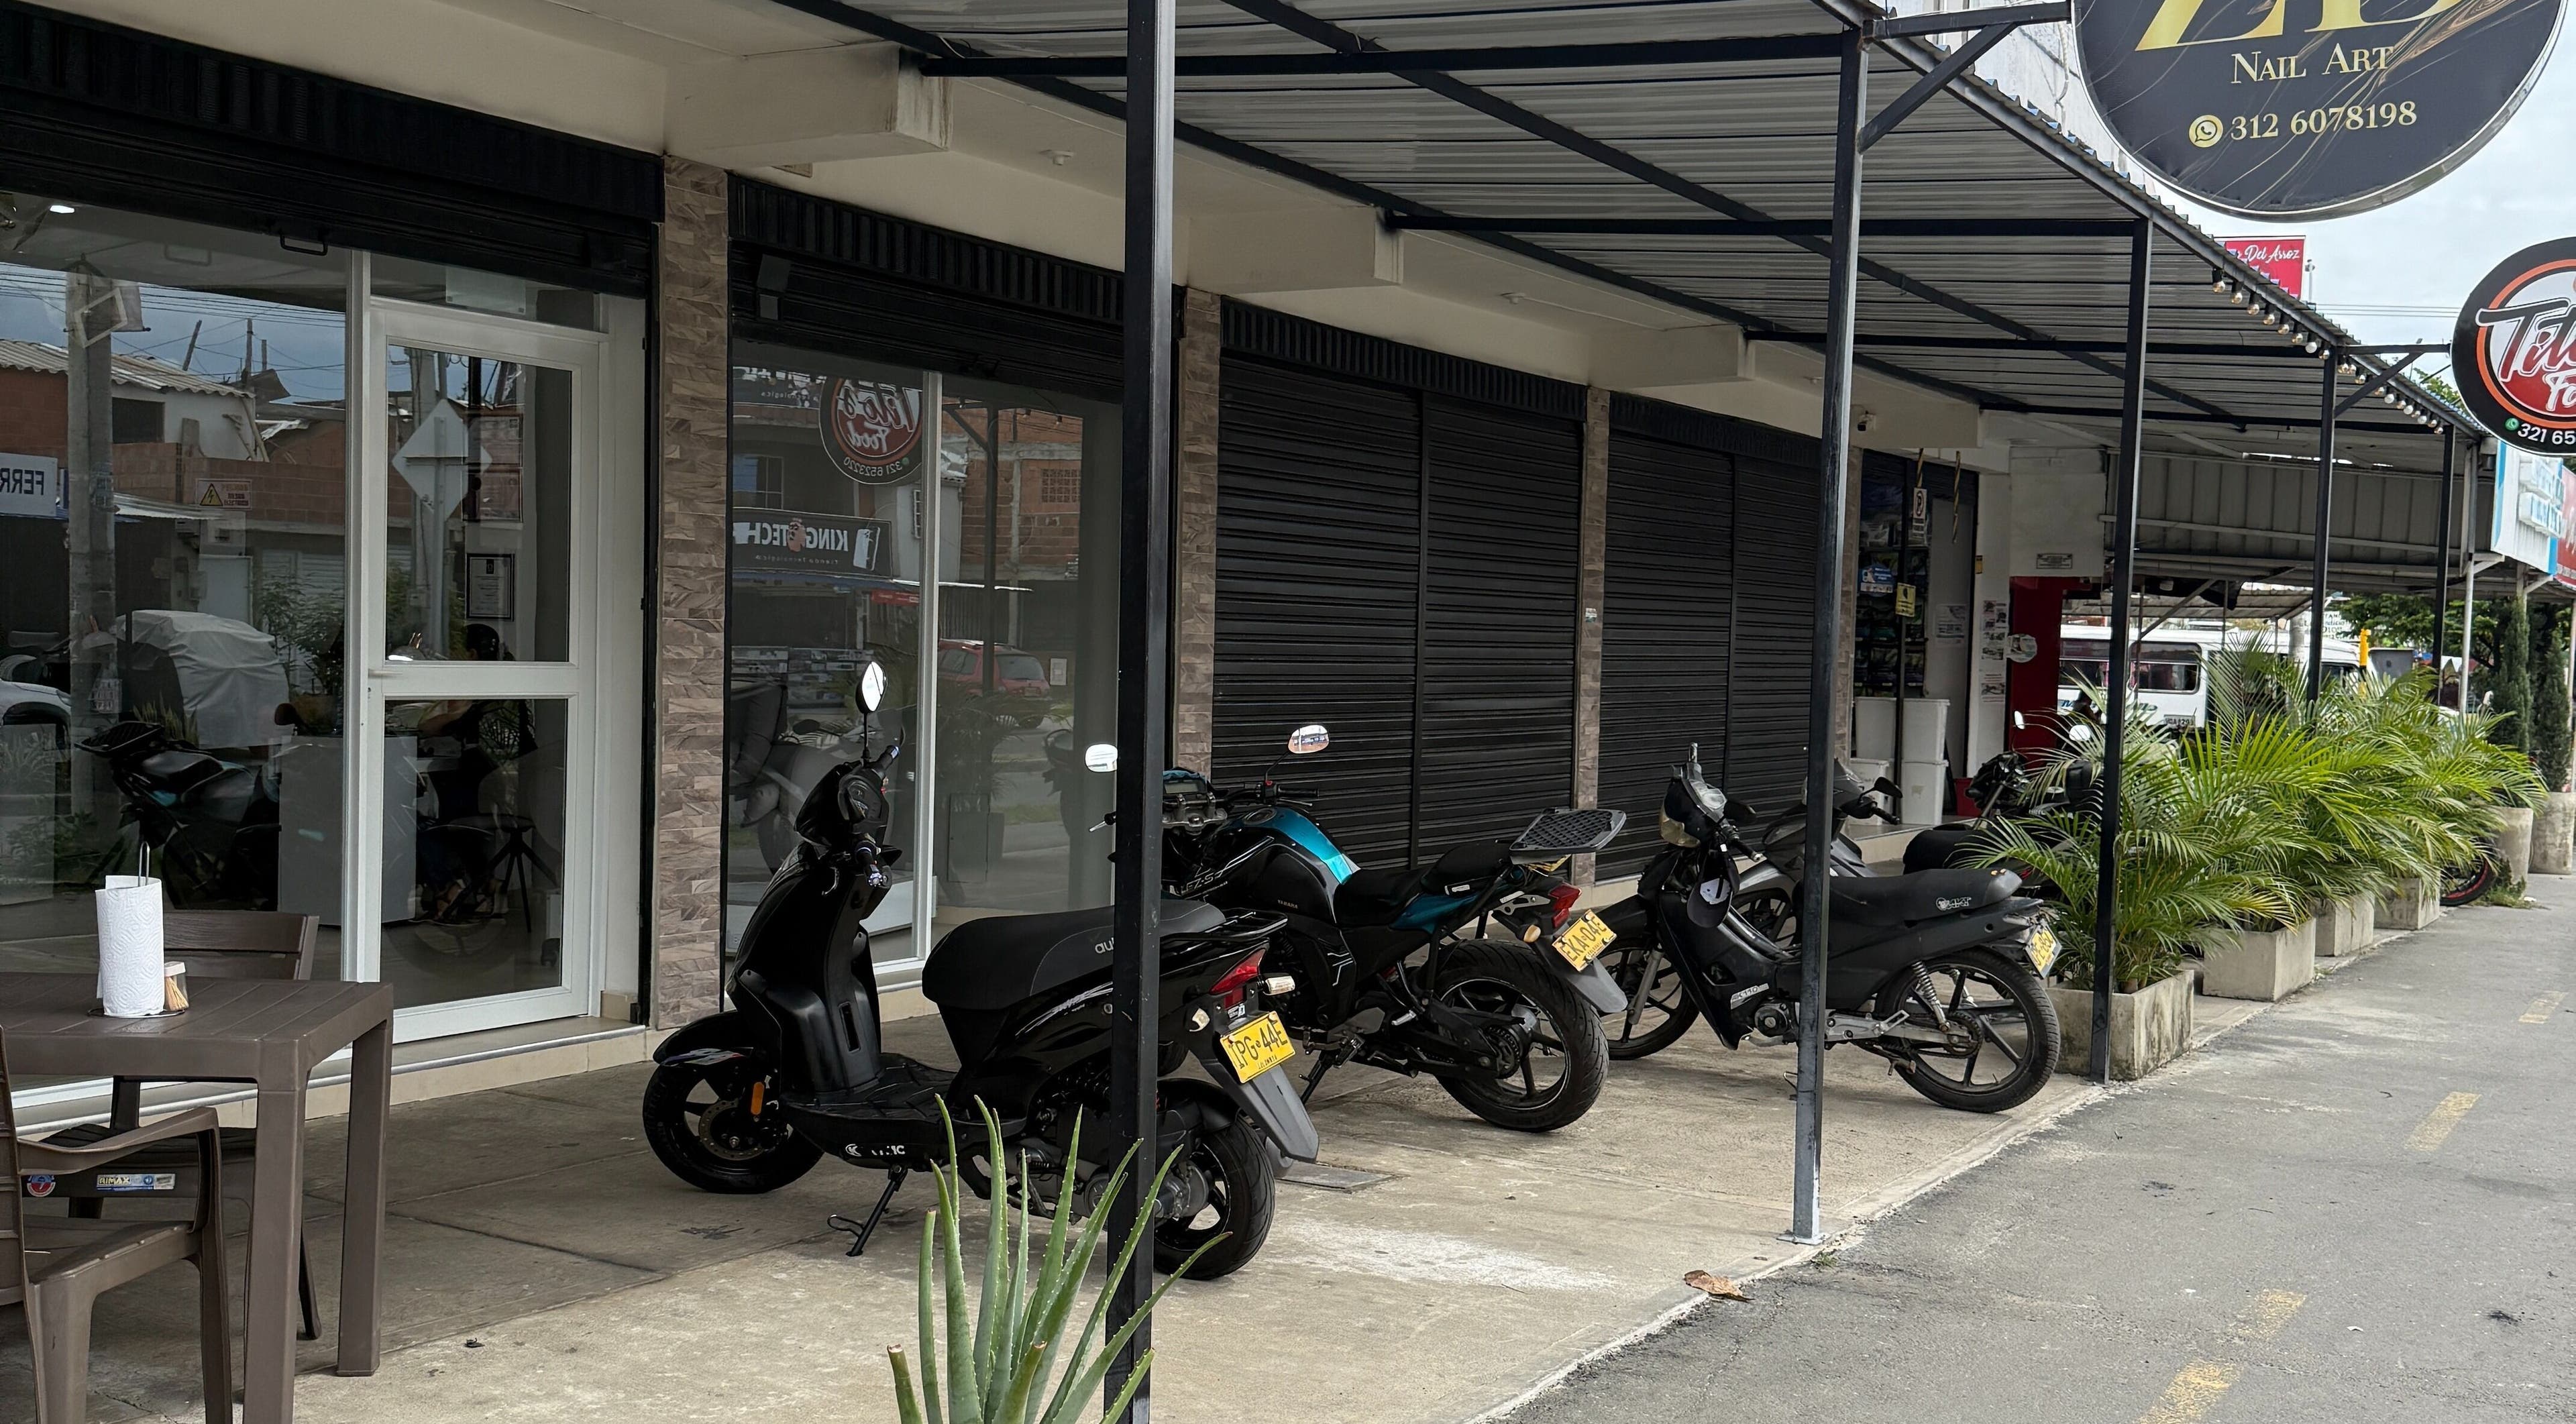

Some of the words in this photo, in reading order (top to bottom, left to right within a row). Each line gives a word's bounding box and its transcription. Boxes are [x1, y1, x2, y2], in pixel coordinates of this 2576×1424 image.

[2231, 113, 2279, 140] 312
[2290, 101, 2417, 135] 6078198
[2245, 244, 2266, 262] Del
[2265, 244, 2300, 263] Arroz
[2517, 423, 2547, 443] 321
[2552, 431, 2576, 445] 65
